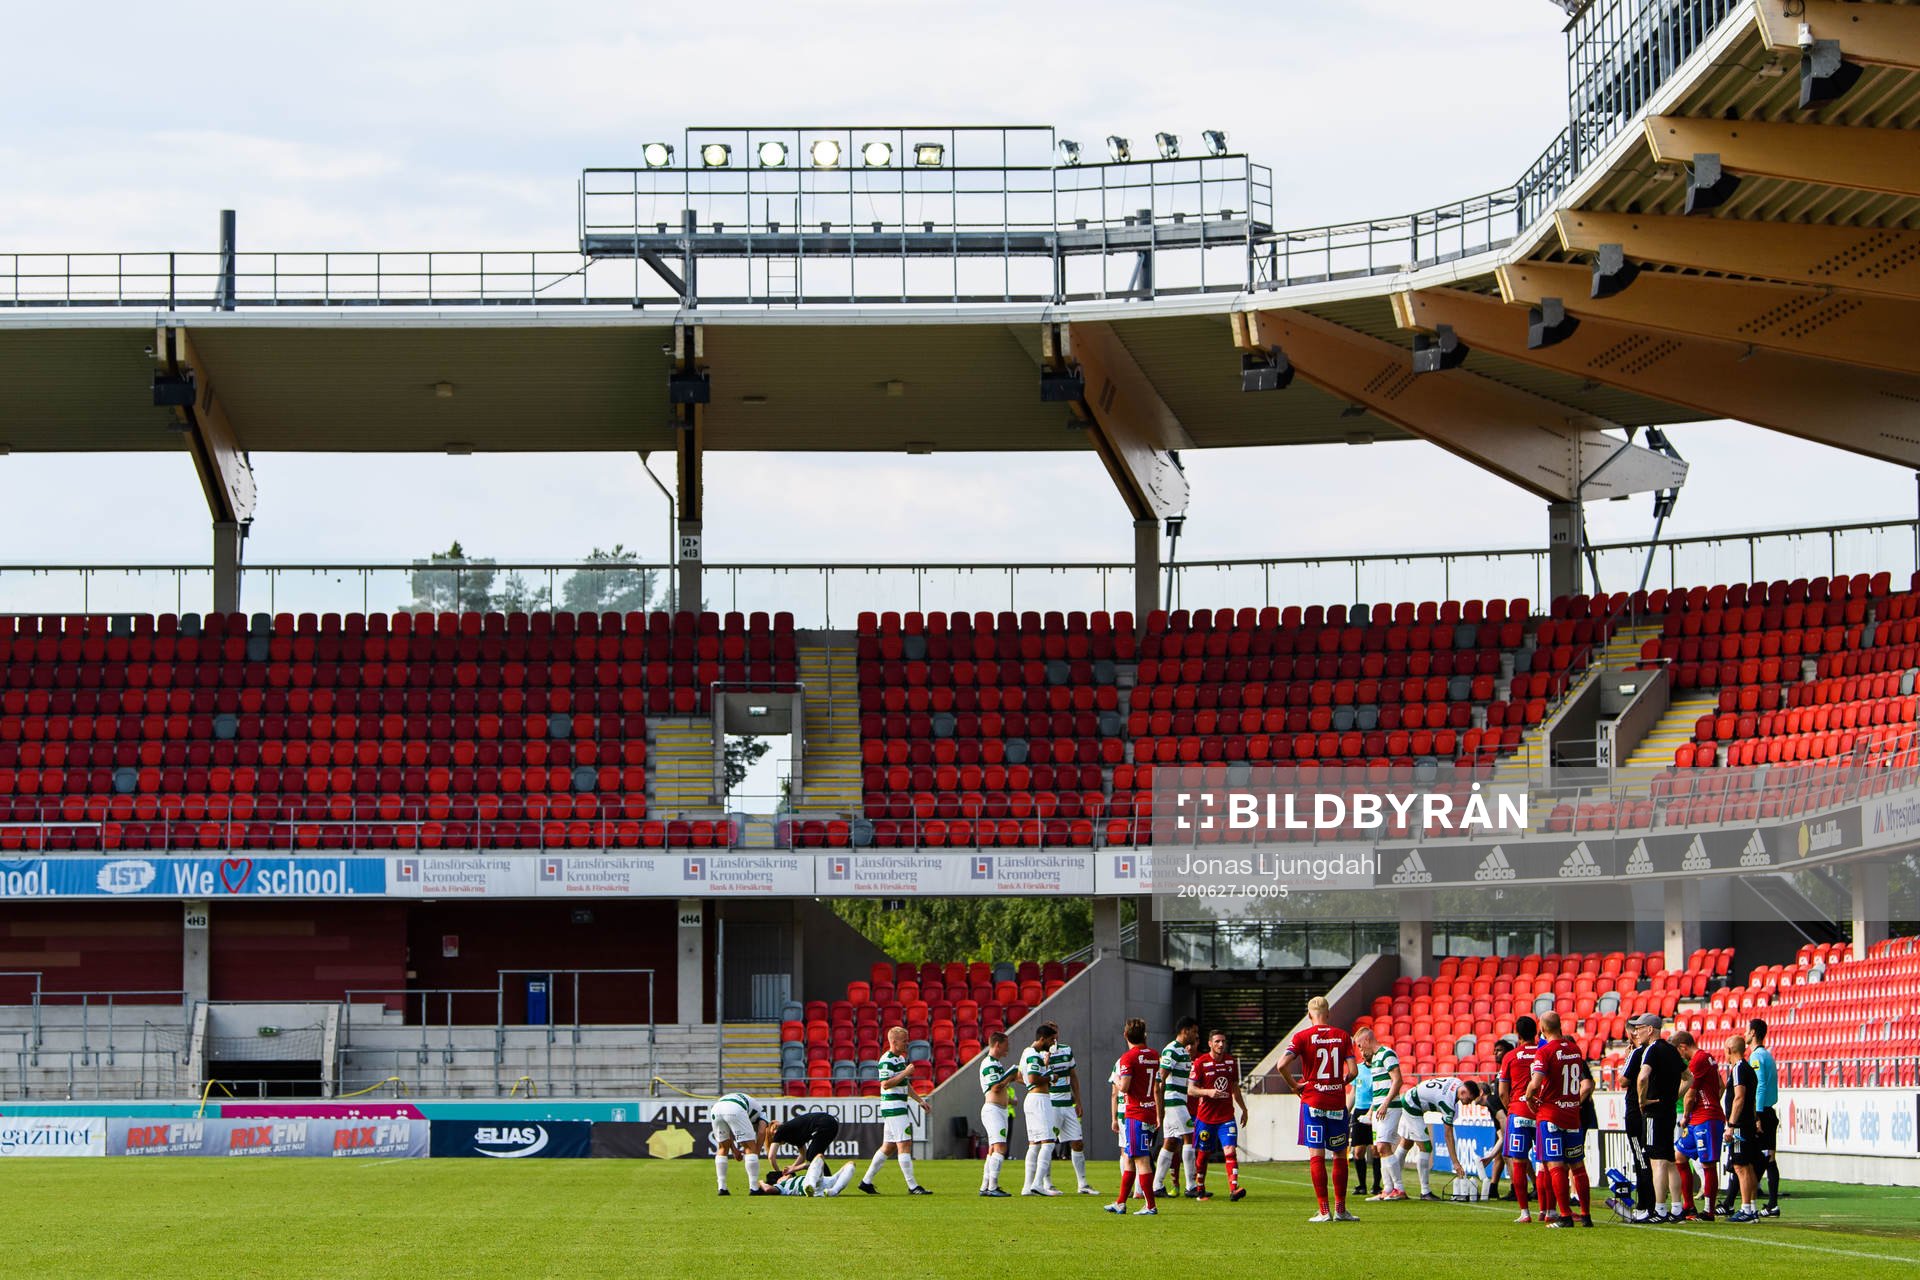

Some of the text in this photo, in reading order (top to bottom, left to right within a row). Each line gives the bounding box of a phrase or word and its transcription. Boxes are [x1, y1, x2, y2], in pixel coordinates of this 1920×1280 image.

[682, 538, 691, 547] 12
[689, 549, 698, 558] 13
[423, 858, 511, 872] Länsförsäkring
[566, 858, 655, 871] Länsförsäkring
[710, 857, 798, 870] Länsförsäkring
[854, 856, 942, 870] Länsförsäkring
[998, 856, 1085, 869] Länsförsäkring
[1682, 858, 1711, 871] adidas
[1740, 853, 1770, 867] adidas
[998, 869, 1061, 881] Kronoberg
[1474, 868, 1516, 881] adidas
[1559, 864, 1601, 877] adidas
[1626, 862, 1654, 875] adidas
[110, 867, 145, 885] IST
[174, 861, 354, 895] We school.
[423, 872, 486, 884] Kronoberg
[566, 871, 630, 884] Kronoberg
[710, 870, 773, 883] Kronoberg
[854, 870, 918, 882] Kronoberg
[1392, 871, 1432, 884] adidas
[193, 916, 206, 926] H3
[686, 915, 700, 924] H4
[1317, 1047, 1339, 1079] 21
[1146, 1069, 1153, 1097] 7
[1562, 1063, 1580, 1095] 18
